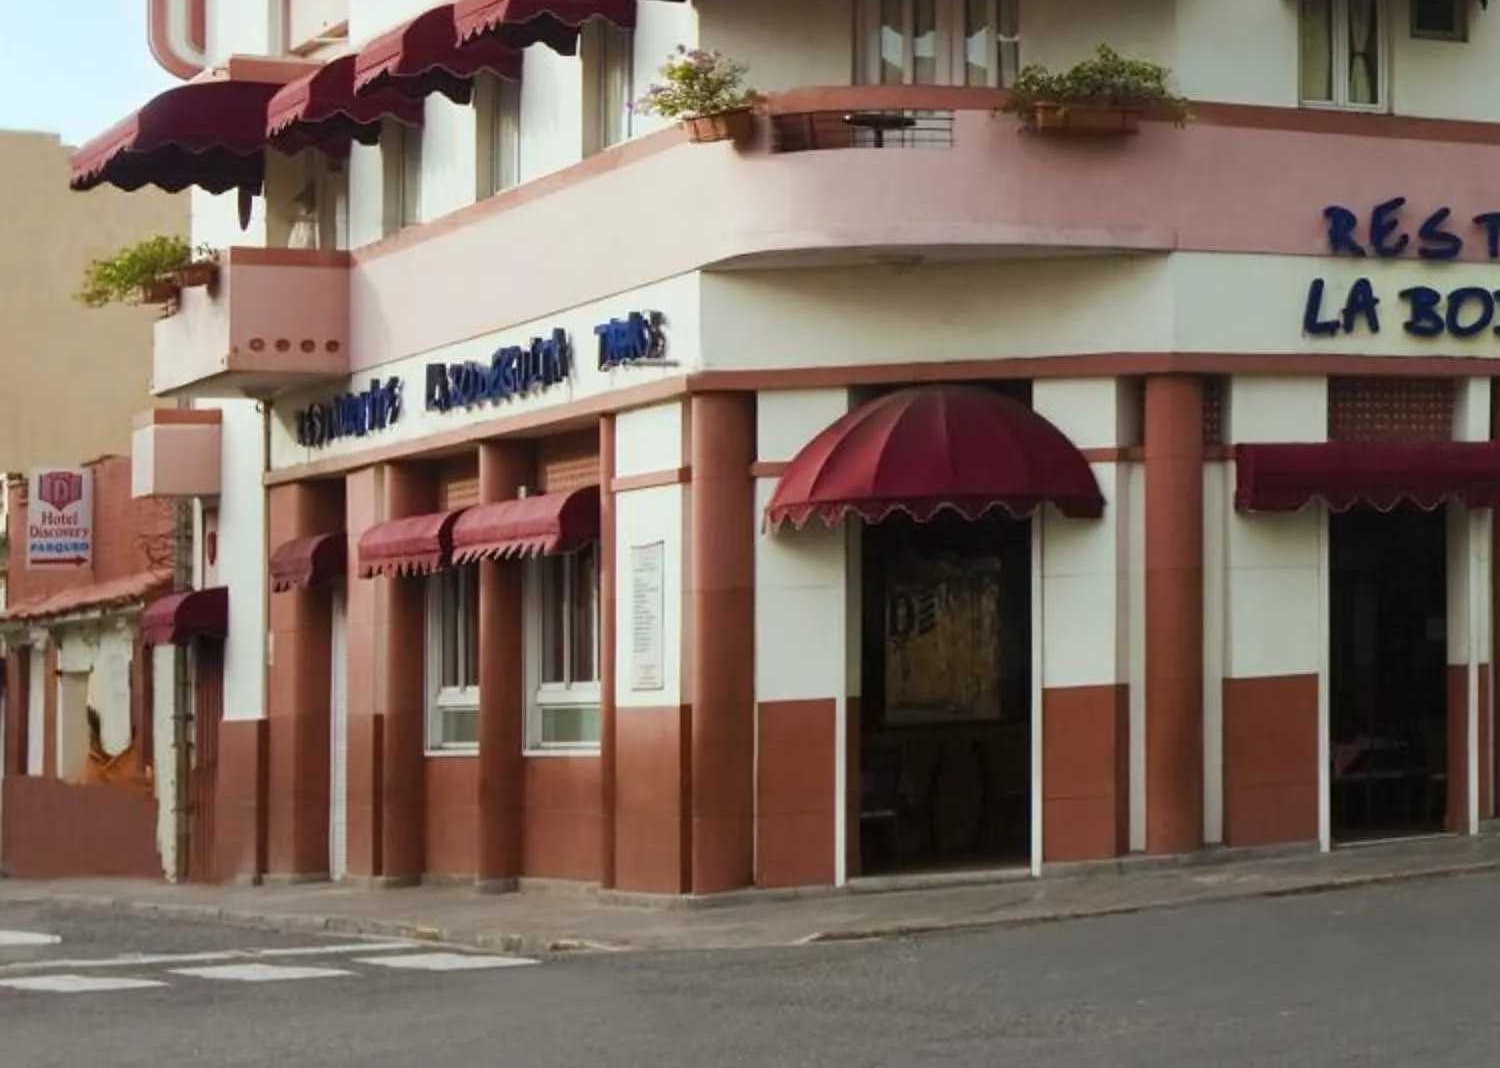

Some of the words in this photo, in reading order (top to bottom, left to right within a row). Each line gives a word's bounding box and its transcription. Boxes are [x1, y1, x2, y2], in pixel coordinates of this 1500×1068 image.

[1303, 277, 1380, 337] LA
[41, 511, 78, 525] Hotel
[29, 525, 90, 539] Discovery
